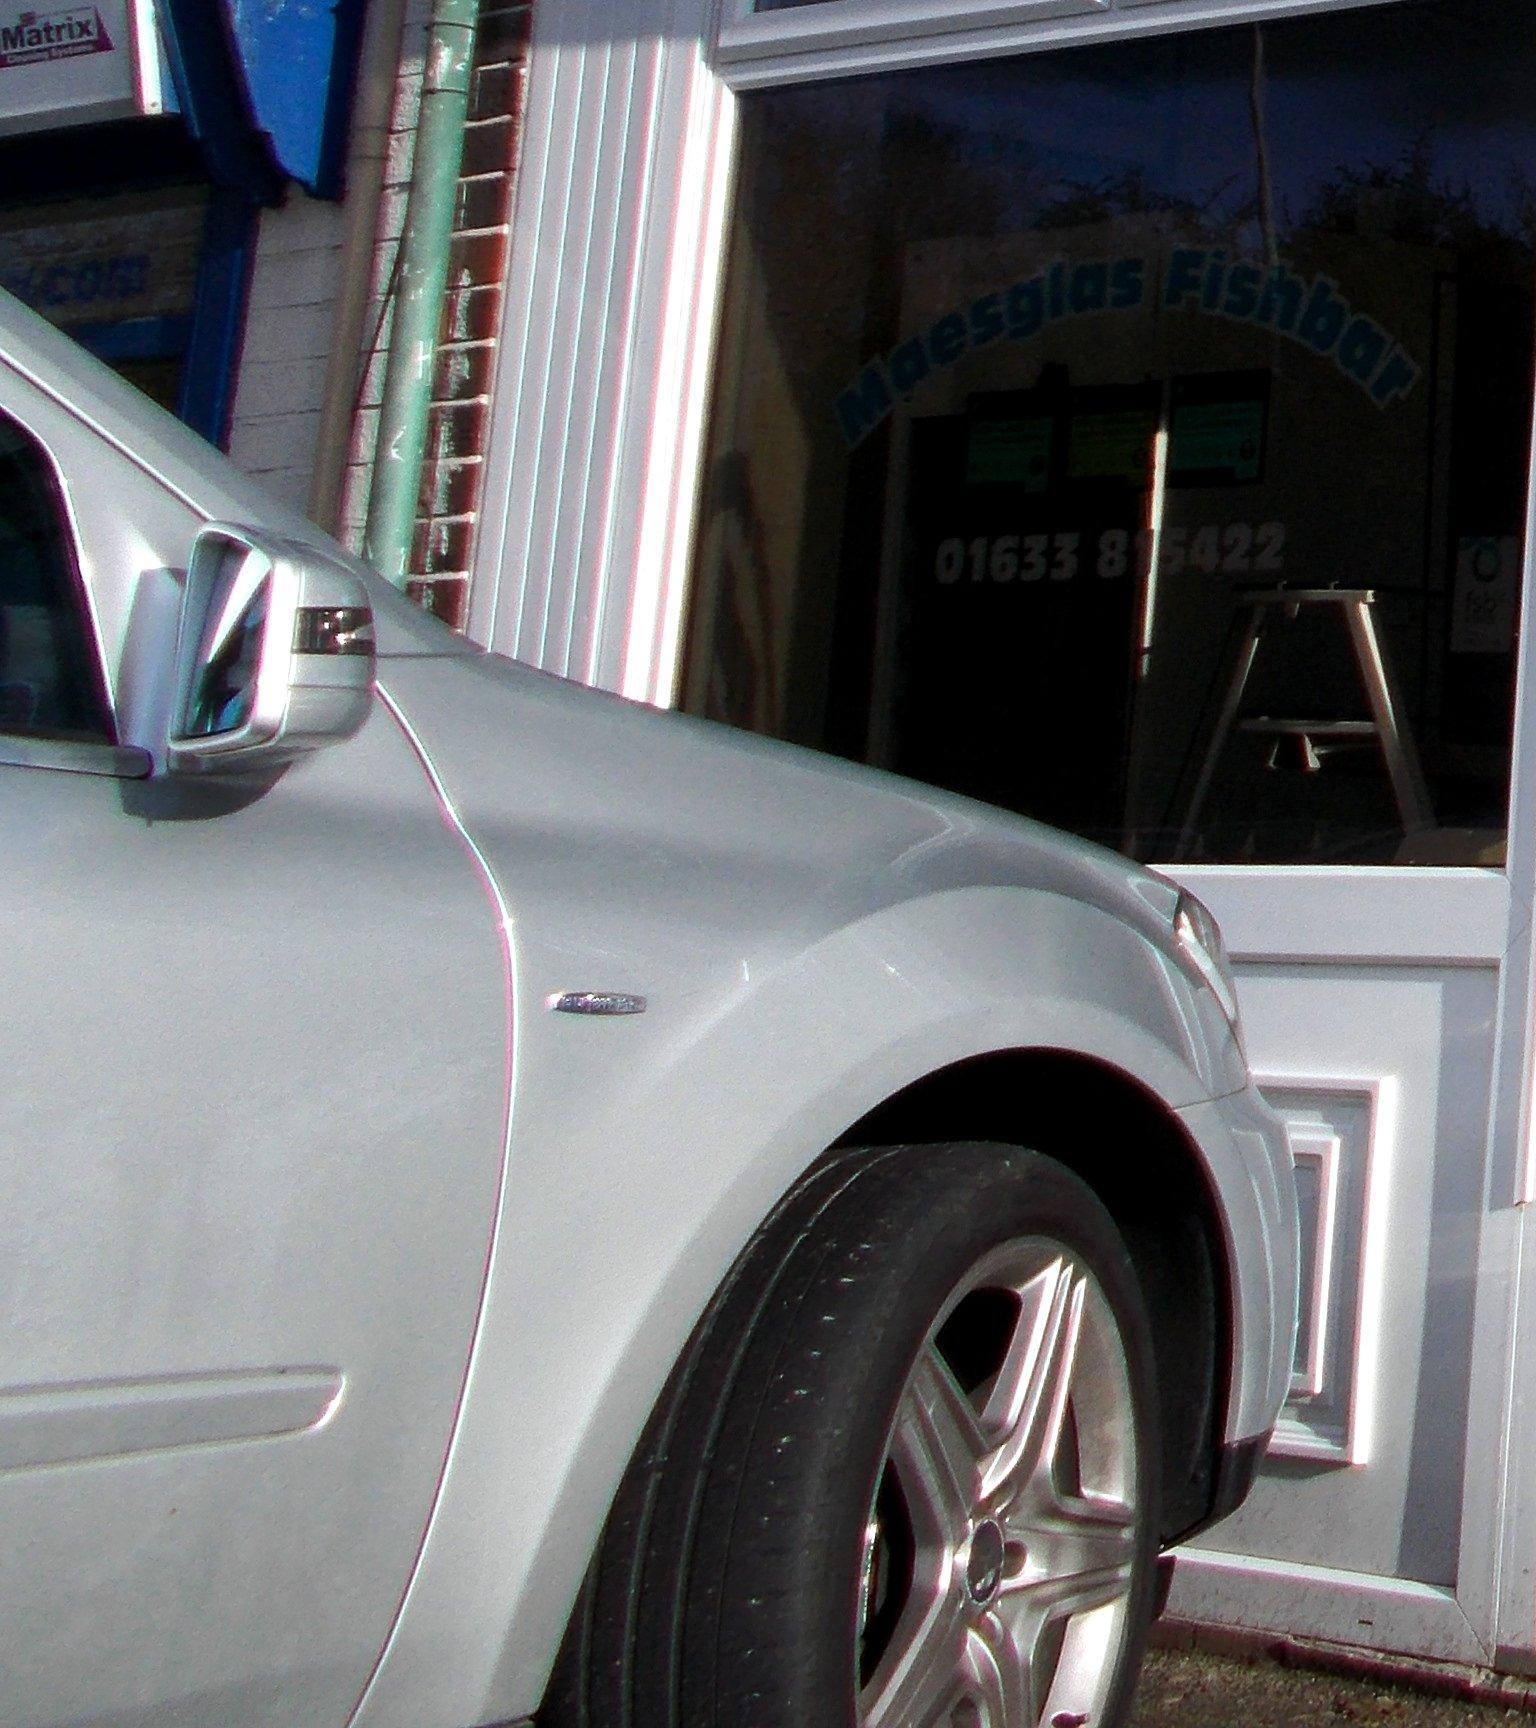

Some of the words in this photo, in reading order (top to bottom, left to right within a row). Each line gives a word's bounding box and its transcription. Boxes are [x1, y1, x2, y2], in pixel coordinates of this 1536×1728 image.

[2, 18, 93, 50] Matrix
[832, 256, 1146, 450] Maesglas
[1160, 245, 1423, 410] Fishbar
[934, 531, 1083, 585] 01633
